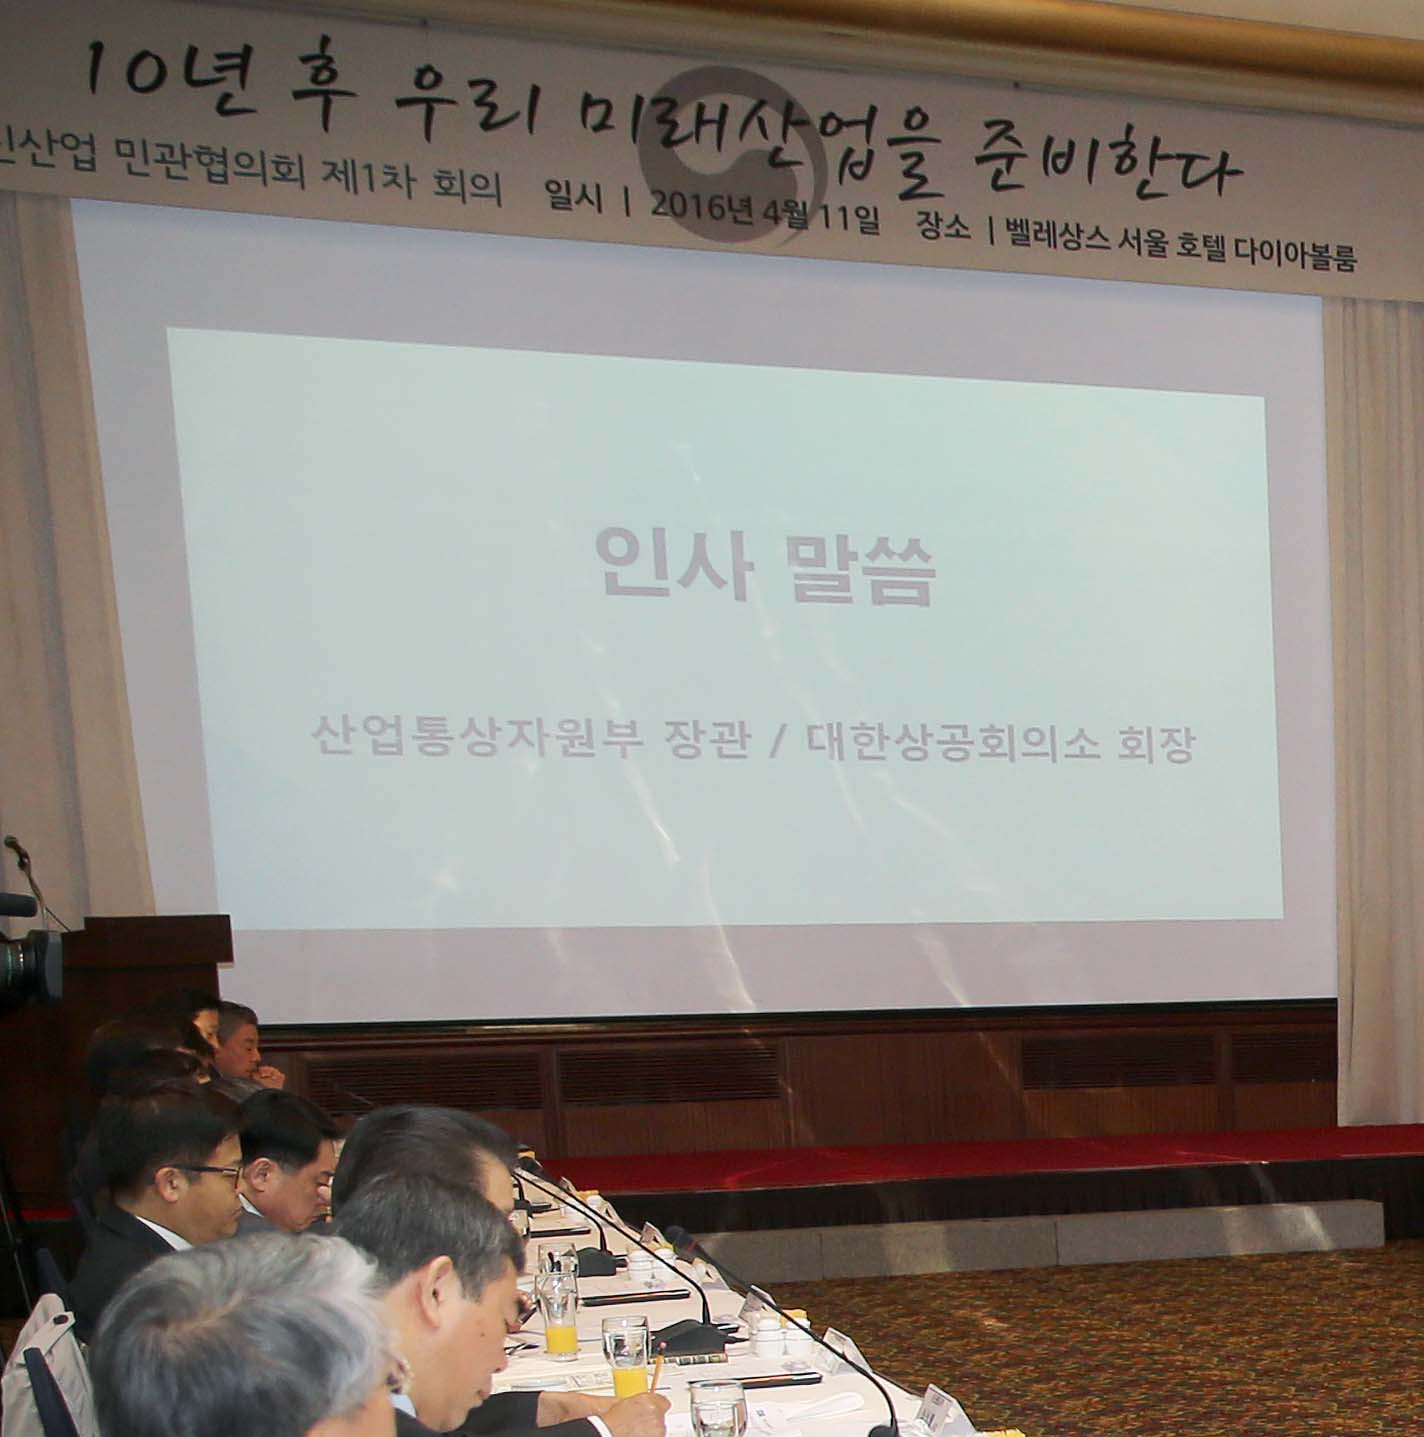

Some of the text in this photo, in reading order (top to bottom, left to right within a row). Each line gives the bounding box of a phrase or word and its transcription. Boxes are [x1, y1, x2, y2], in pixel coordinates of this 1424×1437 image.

[87, 35, 1245, 201] 10년 후 우리 미래산업을 준비한다
[115, 137, 307, 192] 민관협의회
[321, 162, 418, 196] 제1차
[433, 171, 503, 208] 회의
[544, 179, 603, 215] 일시
[650, 189, 754, 226] 2016년
[762, 198, 809, 231] 4월
[818, 203, 881, 237] 11일
[916, 210, 972, 242] 장소
[1005, 216, 1112, 252] 벨레상스
[1117, 227, 1170, 259] 서울
[1176, 230, 1227, 262] 호텔
[1233, 236, 1359, 274] 다이아볼룸
[593, 524, 938, 608] 인사 말씀
[309, 711, 646, 761] 산업통상자원부
[663, 717, 753, 761] 장관
[805, 719, 1103, 764] 대한상공회의소
[1117, 723, 1198, 766] 회장
